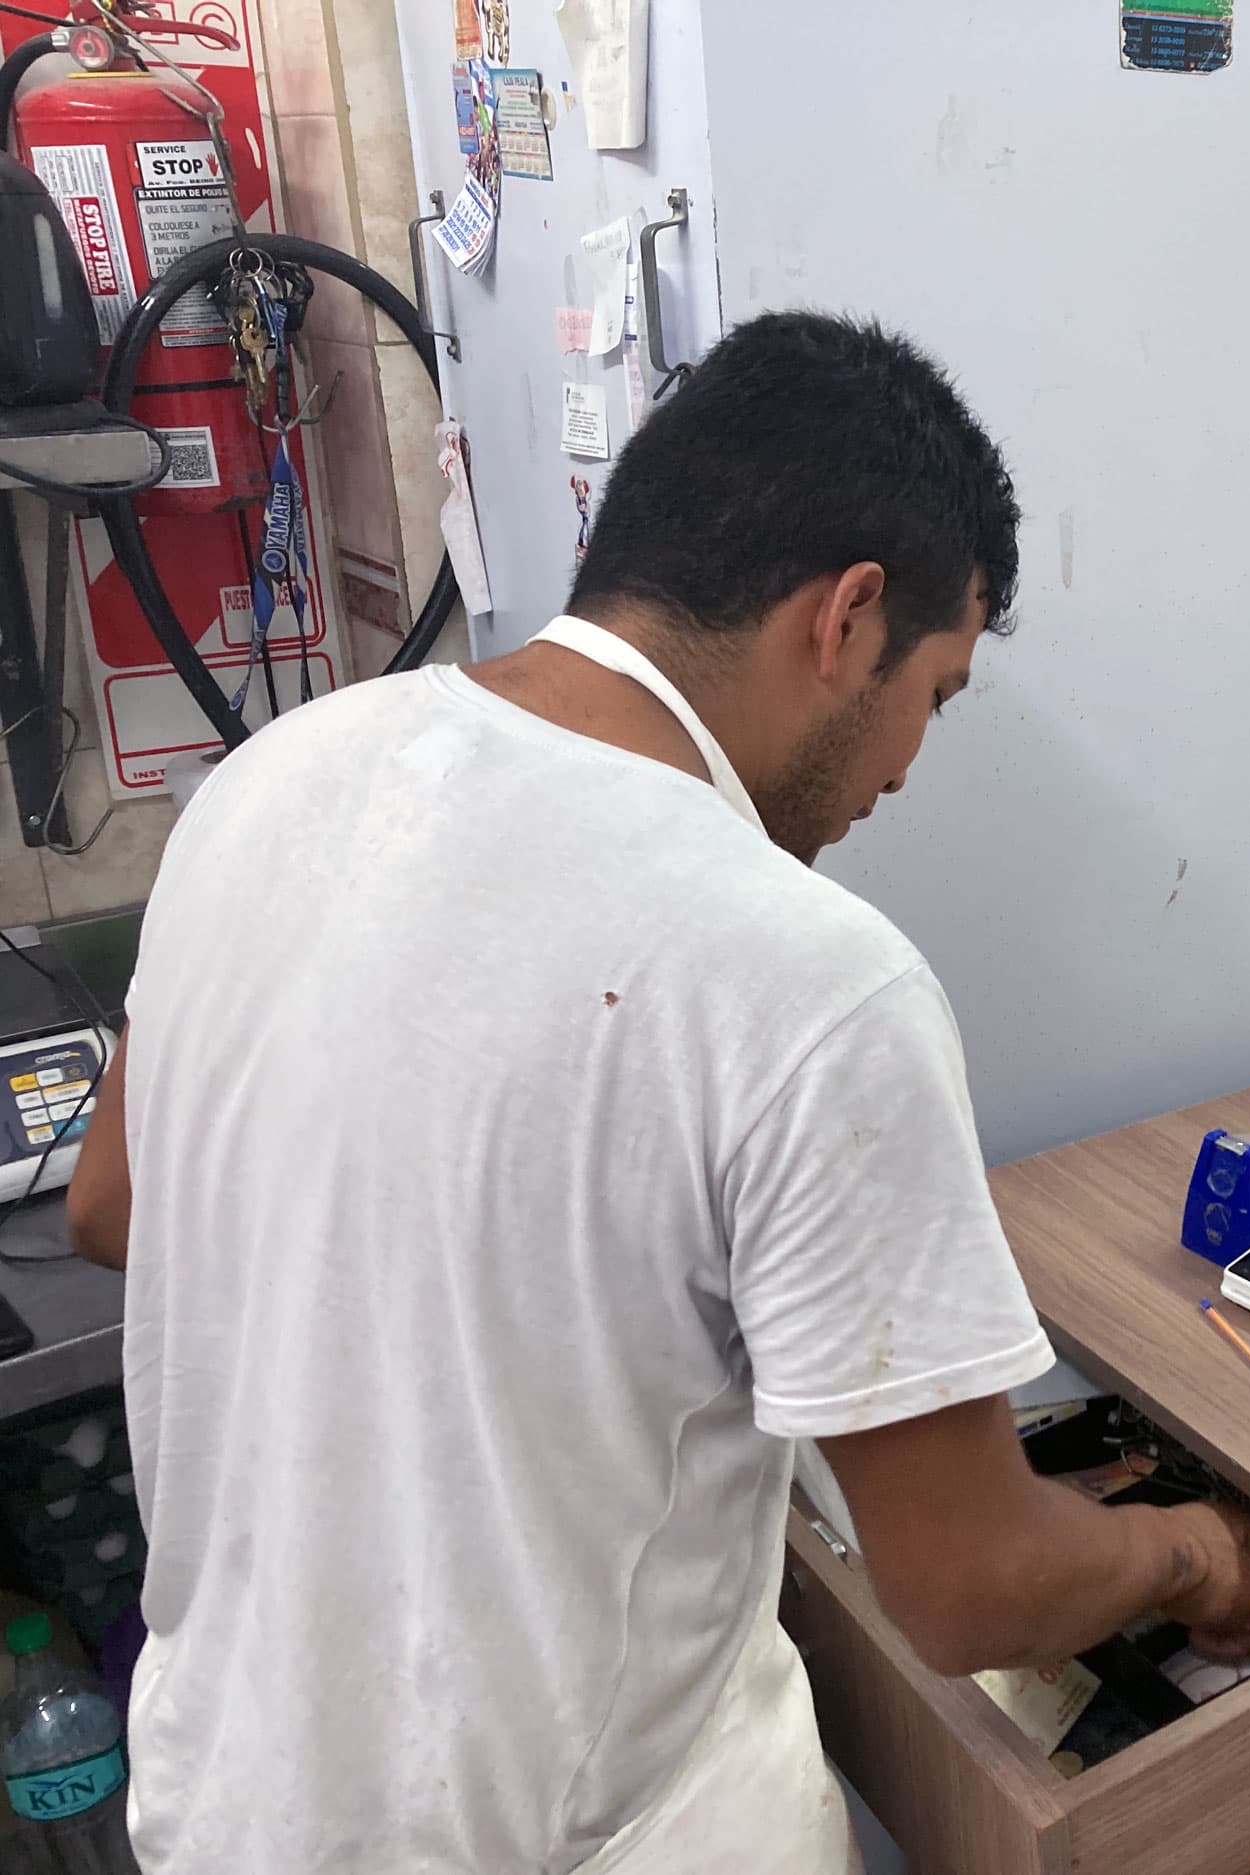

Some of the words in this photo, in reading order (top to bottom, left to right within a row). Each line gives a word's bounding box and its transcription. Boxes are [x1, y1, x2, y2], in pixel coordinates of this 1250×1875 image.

[143, 145, 187, 154] SERVICE
[152, 158, 204, 175] STOP
[138, 188, 187, 198] EXTINTOR
[189, 188, 201, 197] DE
[170, 204, 180, 213] EL
[82, 203, 107, 247] STOP
[148, 221, 193, 231] COLOQUESE
[194, 220, 200, 229] A
[158, 231, 190, 240] METROS
[93, 248, 116, 290] FIRE
[265, 482, 290, 552] YAMAHA
[224, 589, 250, 611] PUEST
[133, 768, 166, 779] INST
[27, 1774, 96, 1812] KIN
